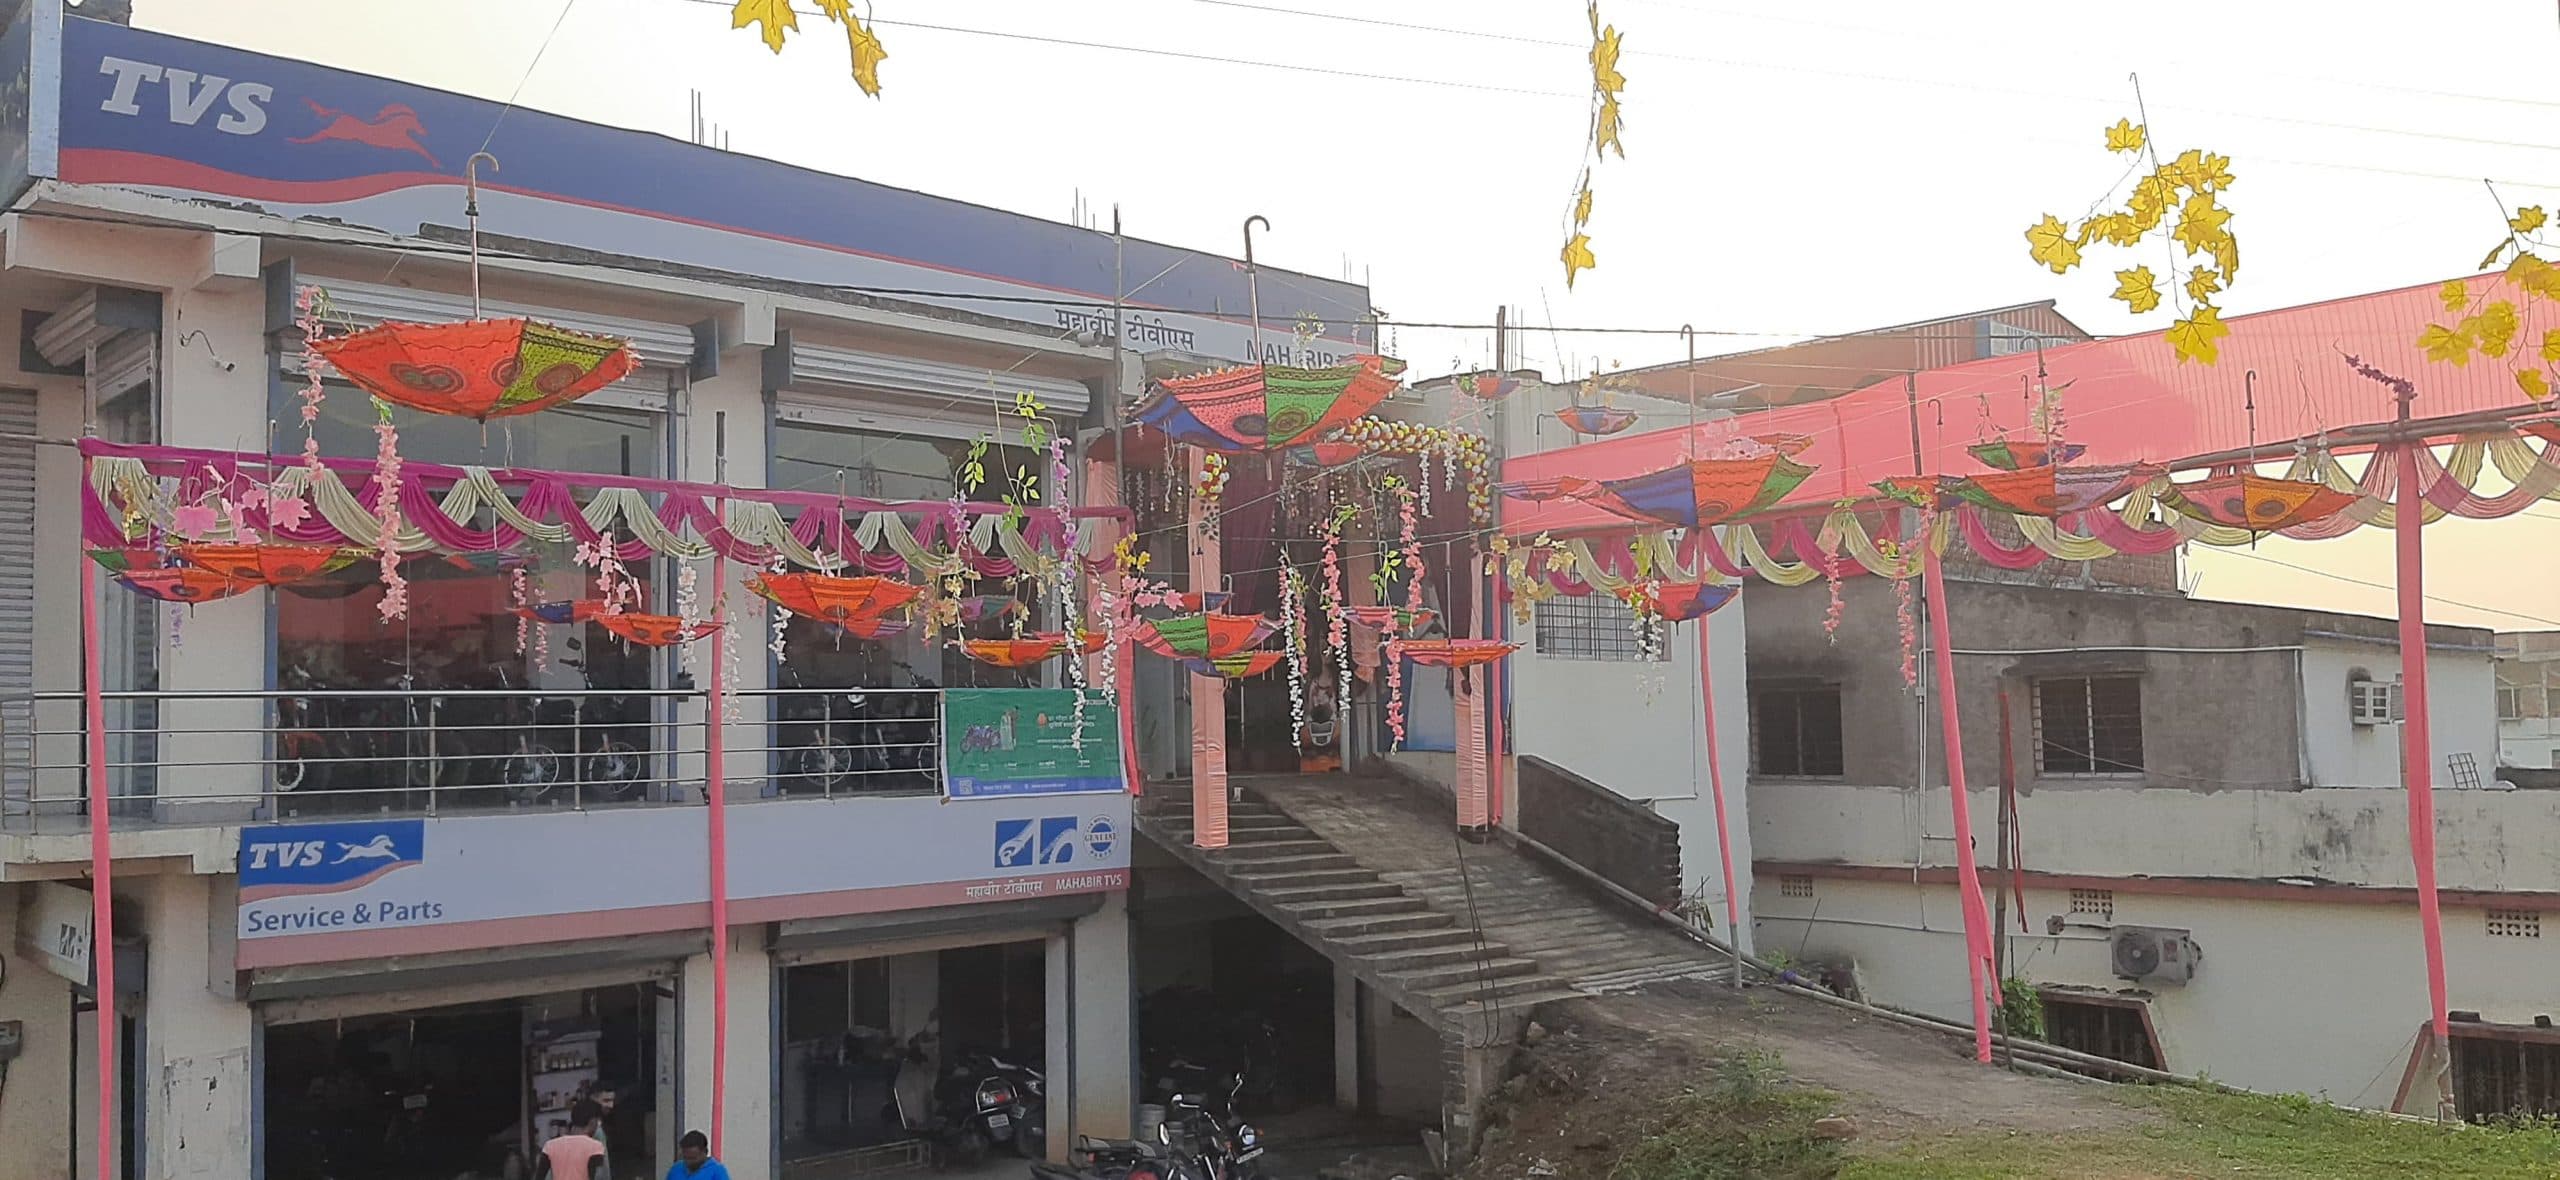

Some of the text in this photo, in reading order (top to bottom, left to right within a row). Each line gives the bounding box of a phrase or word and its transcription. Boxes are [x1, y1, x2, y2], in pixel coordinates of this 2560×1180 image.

[100, 56, 273, 135] TVS
[1125, 314, 1194, 351] टीवीएस
[250, 841, 325, 869] TVS
[966, 879, 1043, 898] महावीर टीवीएस
[1056, 874, 1122, 891] MAHABIR TVS
[247, 899, 443, 933] Service & Parts
